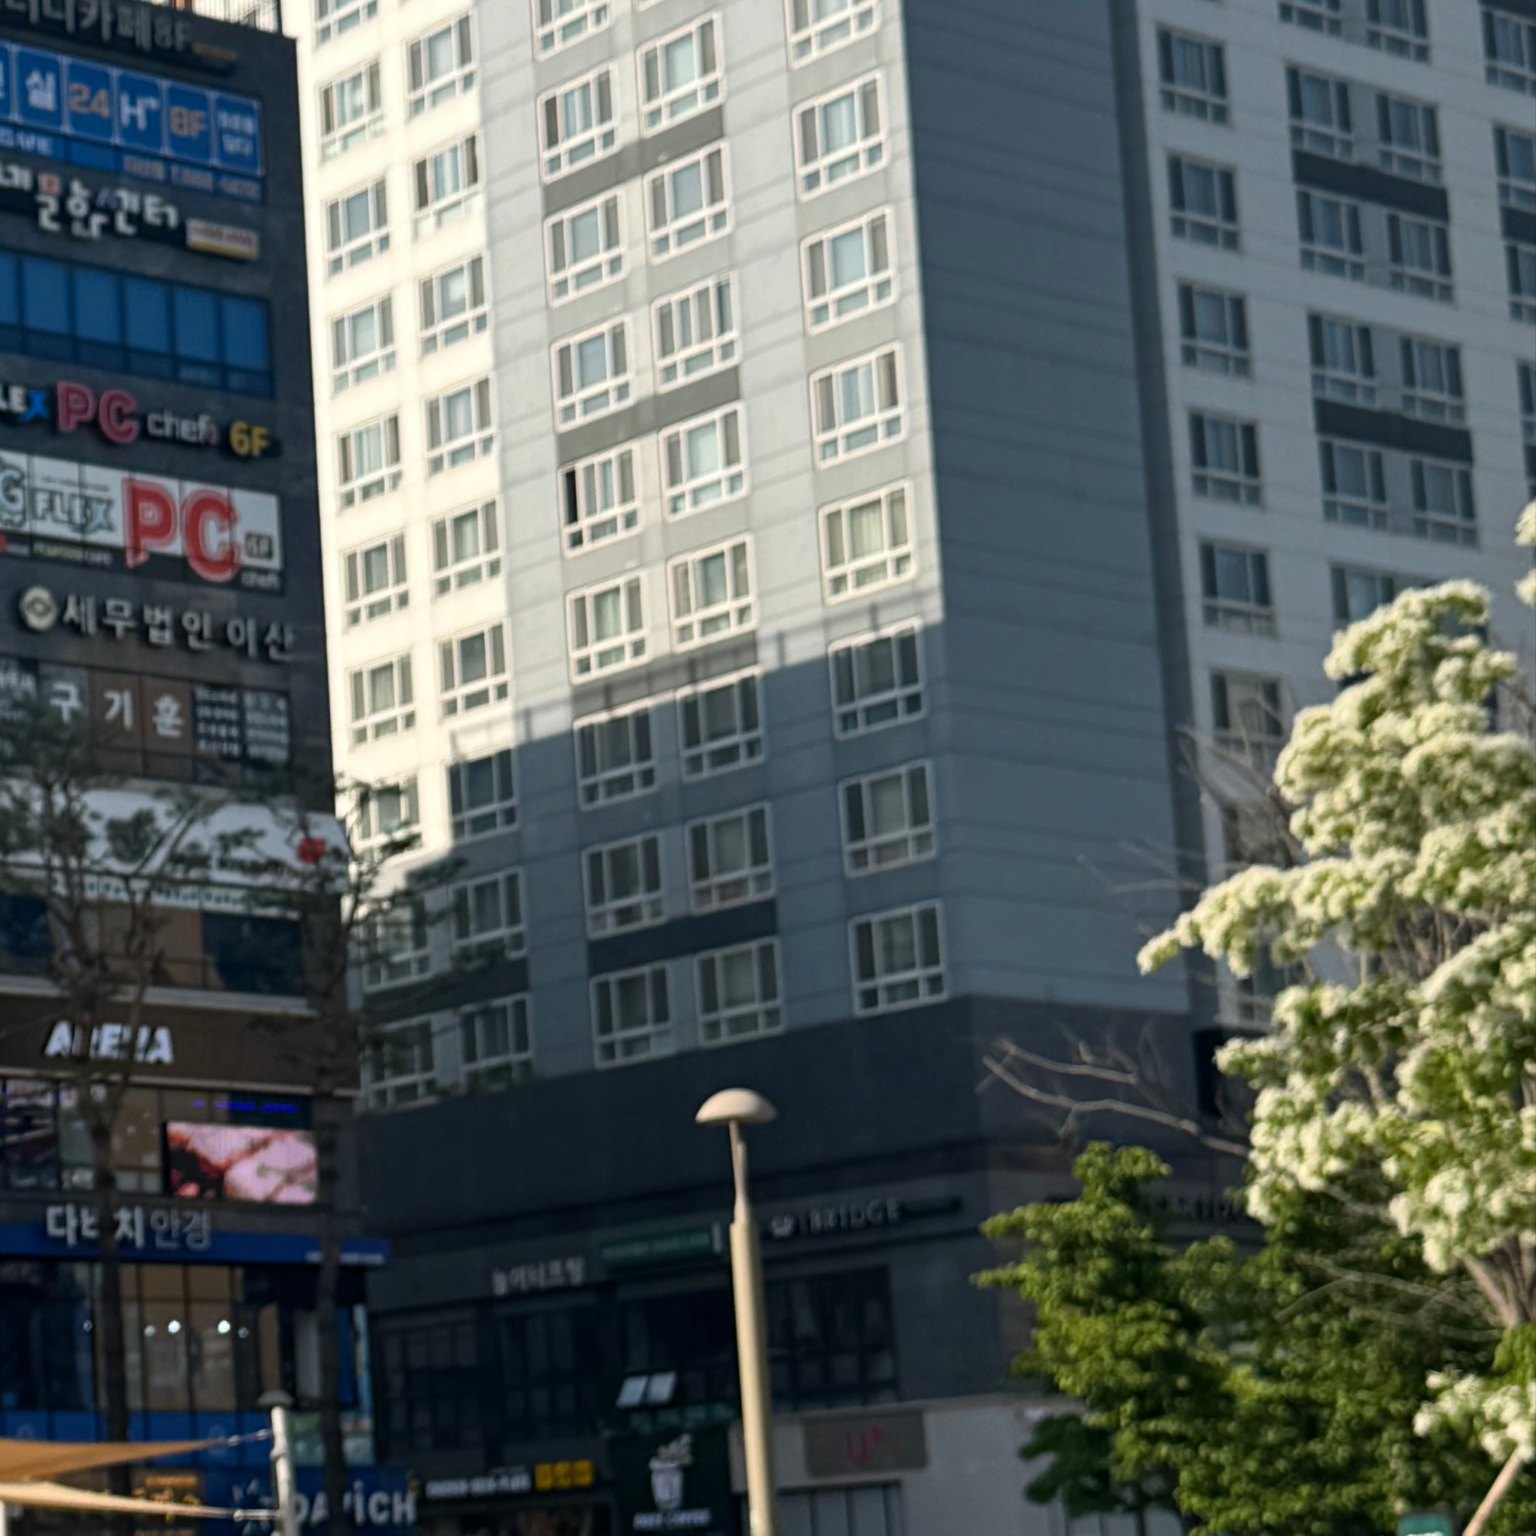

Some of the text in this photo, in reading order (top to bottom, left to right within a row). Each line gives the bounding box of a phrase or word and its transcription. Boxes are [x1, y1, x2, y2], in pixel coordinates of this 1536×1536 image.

[56, 380, 141, 444] PC
[230, 421, 270, 457] 6F
[121, 477, 242, 582] PC
[63, 593, 296, 662] 세무법인 이산
